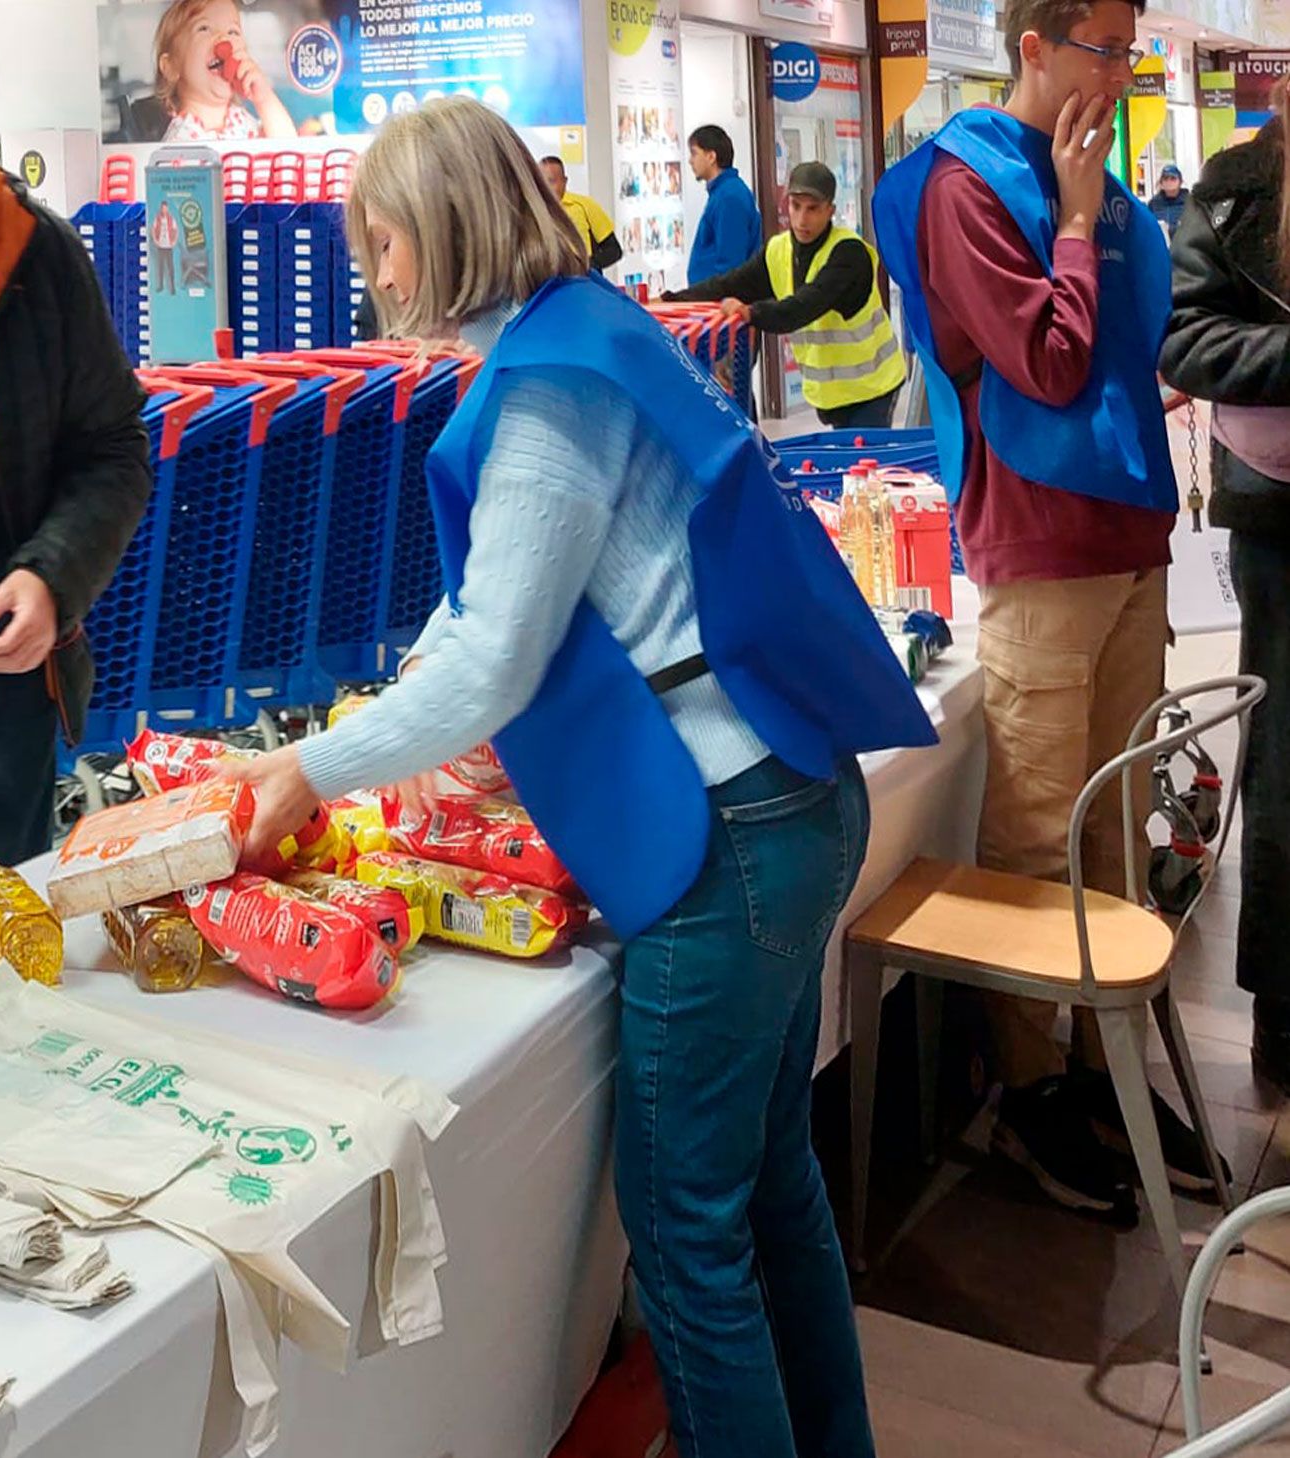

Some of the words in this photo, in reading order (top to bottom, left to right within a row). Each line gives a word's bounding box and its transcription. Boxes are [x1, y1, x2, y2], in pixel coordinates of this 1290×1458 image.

[359, 8, 402, 22] TODOS
[404, 1, 482, 18] MERECEMOS
[360, 25, 376, 38] LO
[378, 22, 420, 37] MEJOR
[423, 19, 439, 33] AL
[441, 16, 484, 32] MEJOR
[487, 13, 535, 28] PRECIO
[299, 43, 317, 55] ACT
[772, 59, 815, 77] DIGI
[1137, 76, 1155, 86] USA
